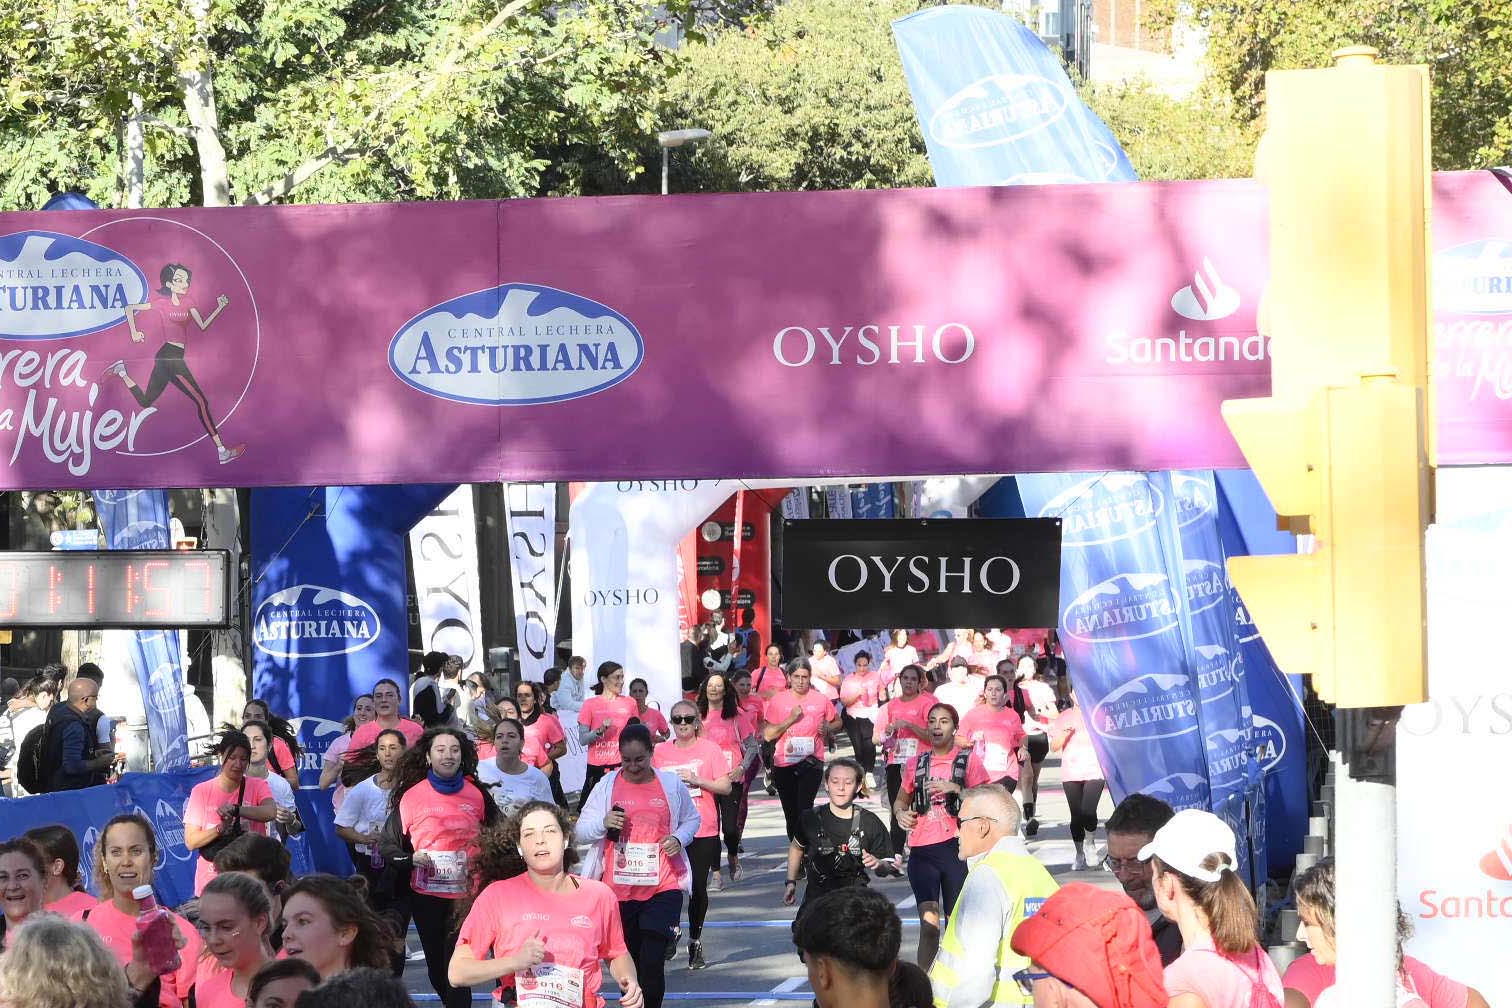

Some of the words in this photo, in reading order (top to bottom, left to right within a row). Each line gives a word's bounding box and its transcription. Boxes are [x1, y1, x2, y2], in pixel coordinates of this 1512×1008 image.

[51, 267, 123, 279] LECHERA
[448, 327, 527, 339] CENTRAL
[534, 324, 616, 337] LECHERA
[772, 322, 976, 367] OYSHO
[1104, 329, 1273, 365] Santand
[408, 330, 624, 375] ASTURIANA
[8, 383, 159, 477] Mujer
[828, 553, 1022, 595] OYSHO
[270, 610, 314, 619] CENTRAL
[317, 609, 367, 618] LECHERA
[584, 587, 659, 608] OYSHO
[257, 614, 371, 643] ASTURIANA
[1399, 694, 1512, 736] OYS
[1418, 889, 1512, 920] Santa
